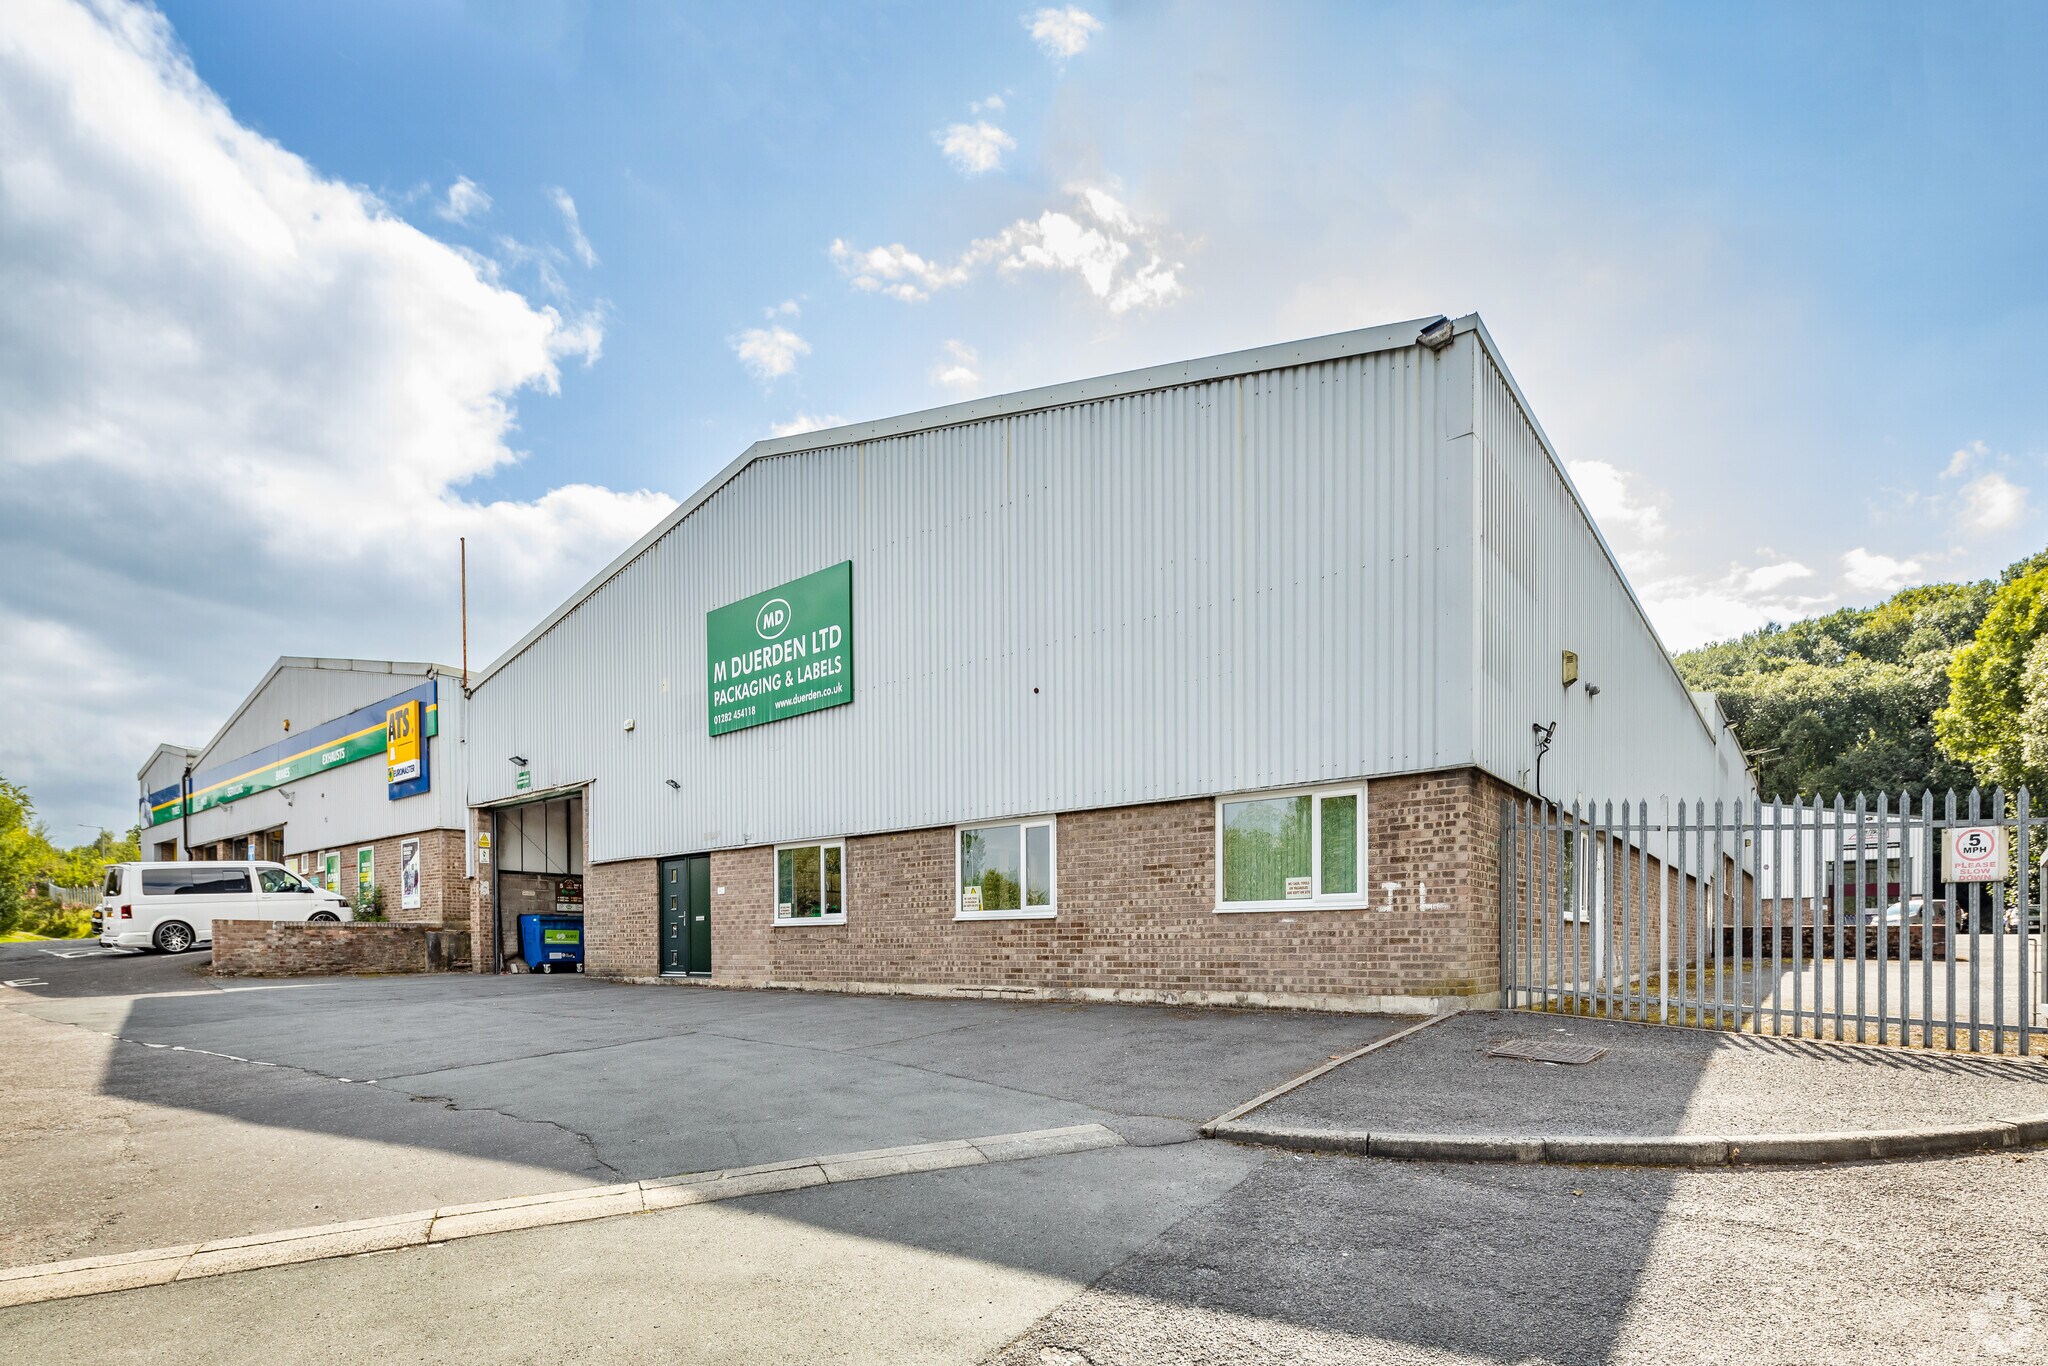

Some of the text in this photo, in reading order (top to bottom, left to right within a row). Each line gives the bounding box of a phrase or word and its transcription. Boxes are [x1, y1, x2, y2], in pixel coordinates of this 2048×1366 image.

[763, 609, 784, 630] MD
[713, 624, 842, 684] M DUERDEN LTD
[714, 655, 842, 706] PACKAGING & LABELS
[774, 682, 843, 709] www.duerden.co.uk
[388, 707, 409, 742] ATS
[713, 706, 756, 725] 01282 454118
[322, 747, 345, 765] EXHAUSTS
[393, 764, 415, 778] EUROMASTER
[1968, 833, 1981, 847] 5
[1963, 846, 1987, 854] MPH
[1954, 861, 1997, 869] PLEASE
